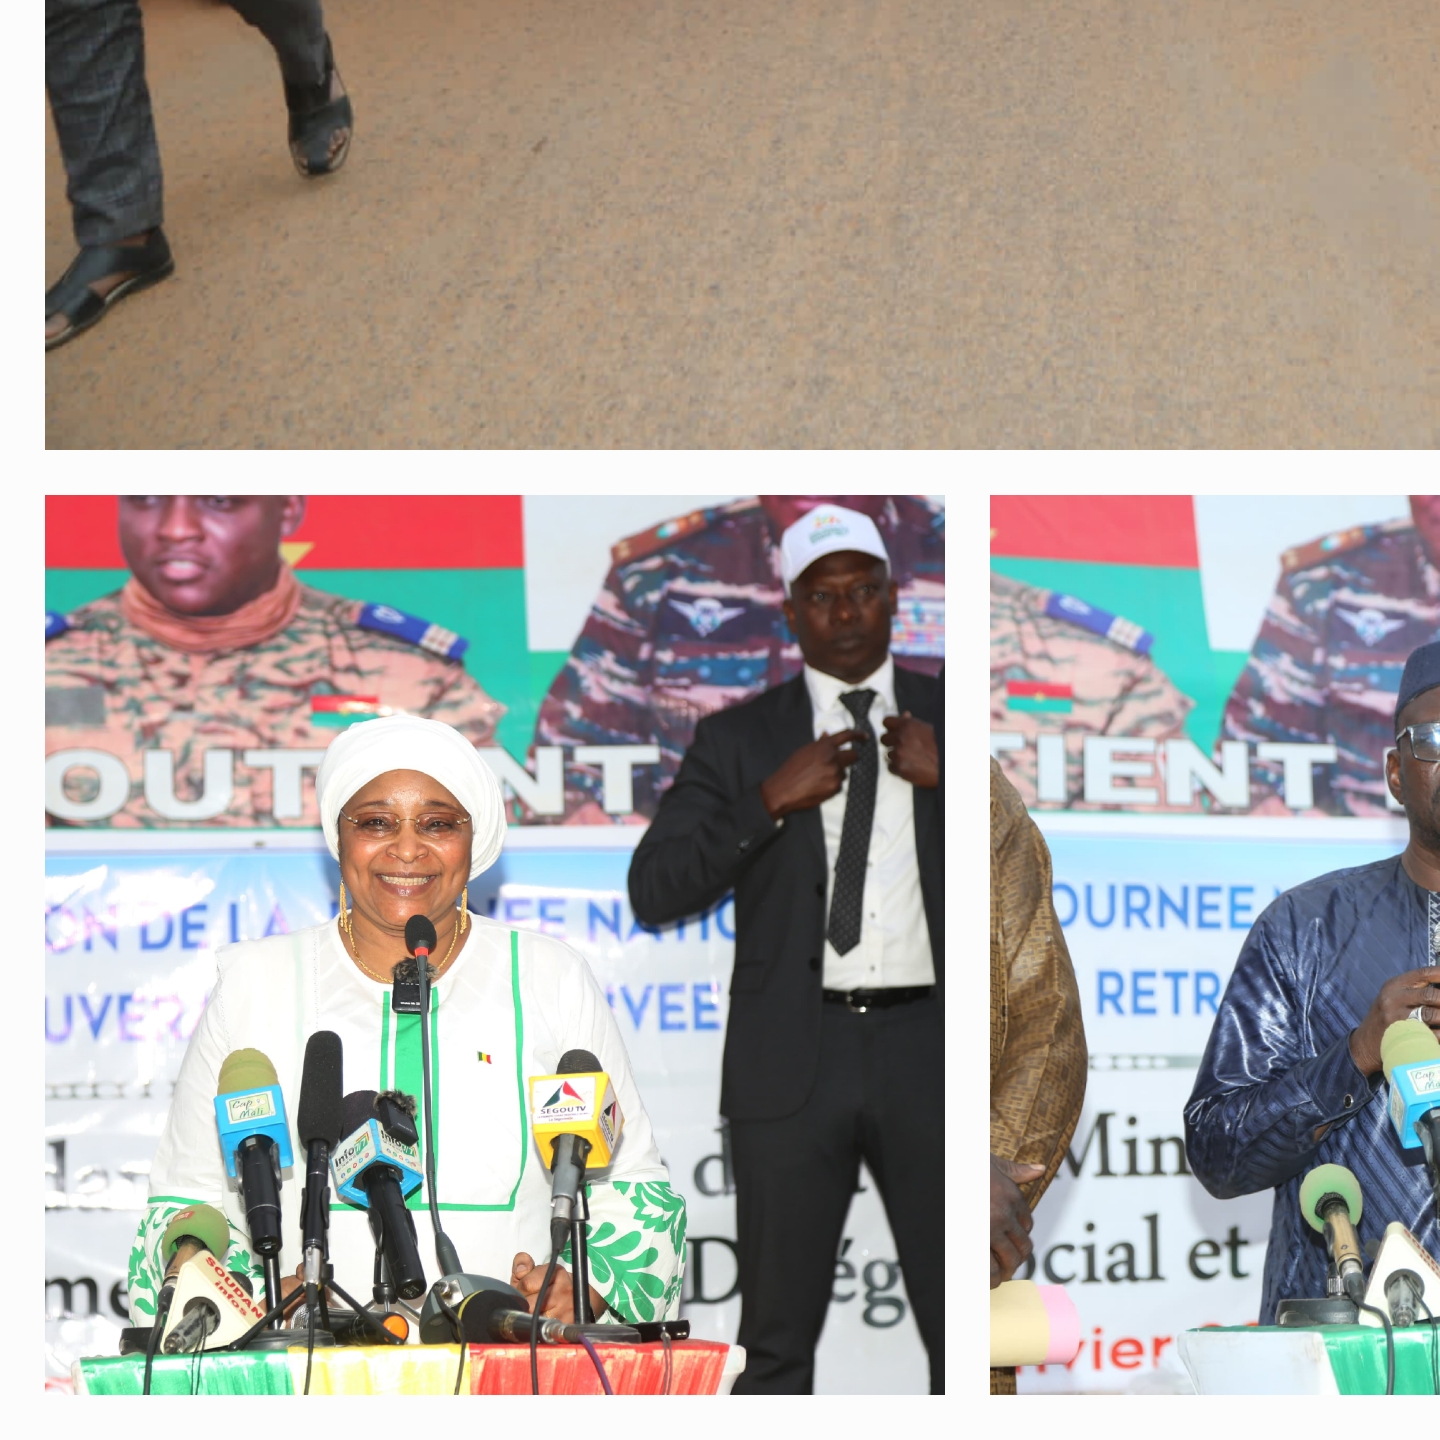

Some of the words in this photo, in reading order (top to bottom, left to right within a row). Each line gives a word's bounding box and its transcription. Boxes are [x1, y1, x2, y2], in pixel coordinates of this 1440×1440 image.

[232, 1100, 253, 1110] Cap
[239, 1107, 264, 1119] Mali
[540, 1106, 574, 1115] SEGOU
[334, 1146, 355, 1168] Info
[1188, 1226, 1250, 1281] et
[206, 1256, 263, 1319] SOUDAN
[215, 1280, 248, 1317] infos
